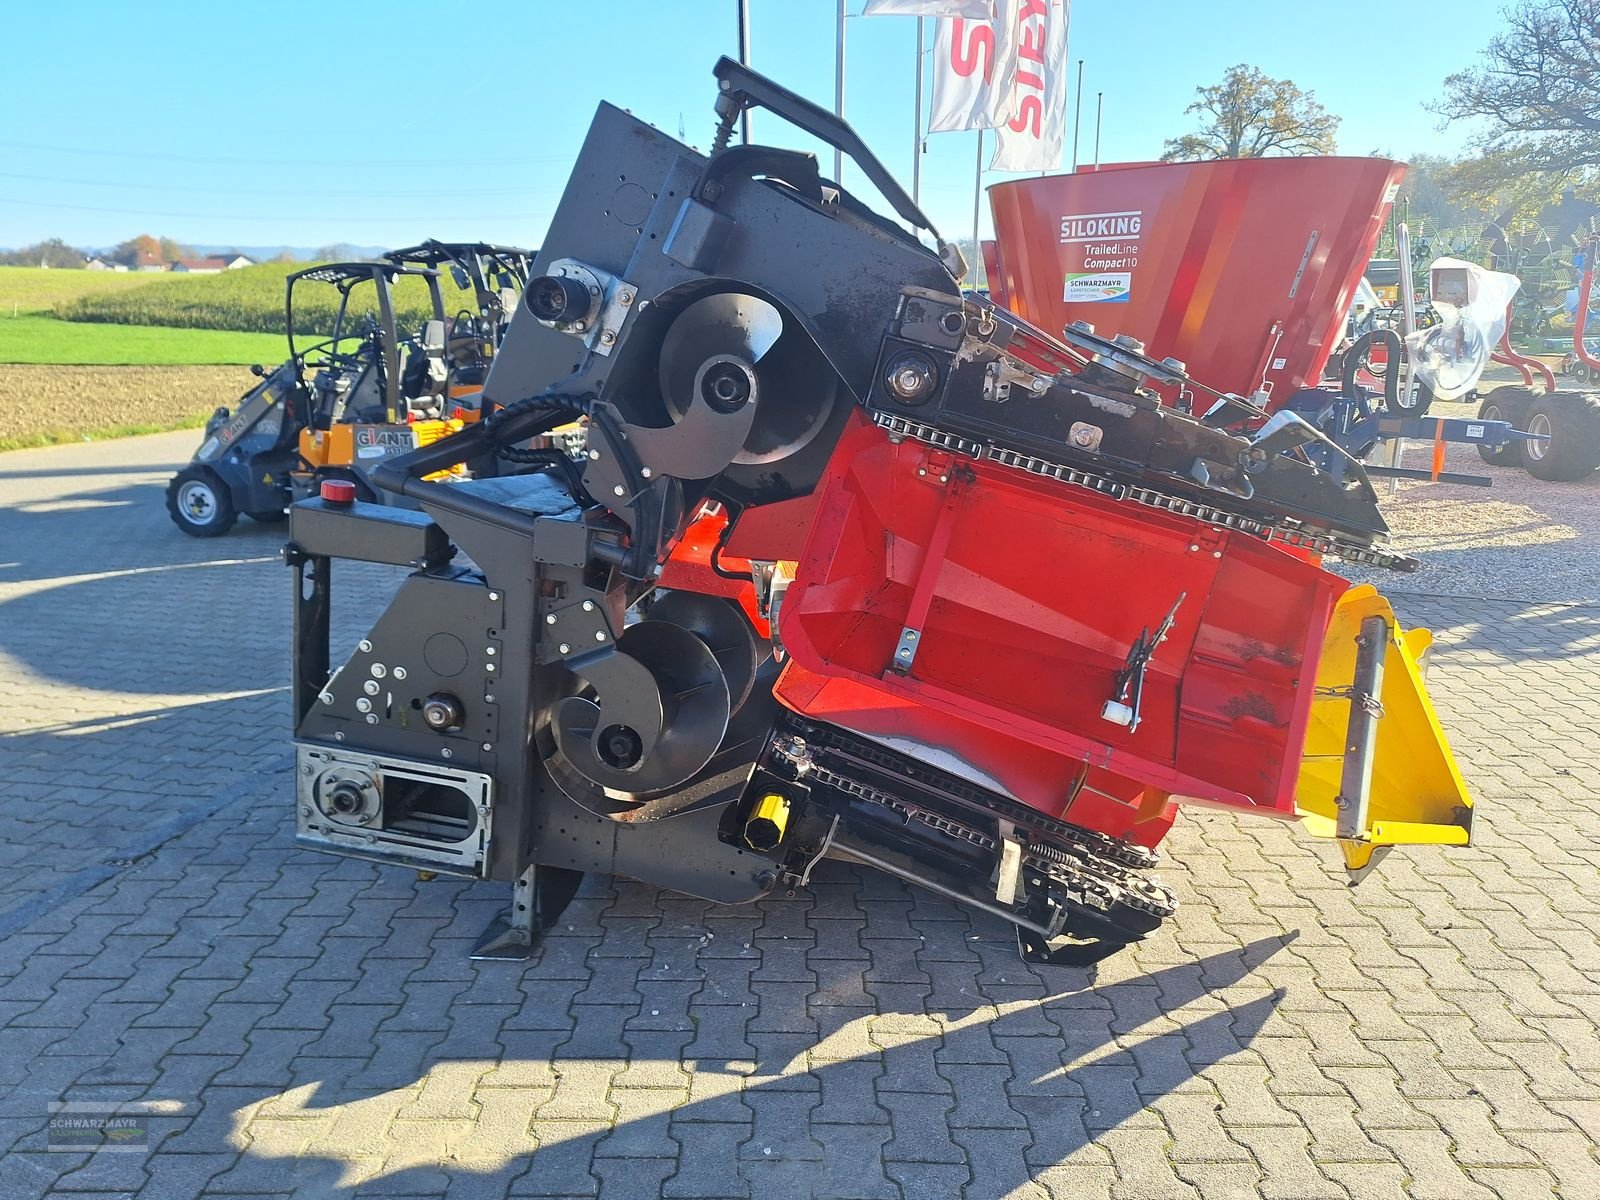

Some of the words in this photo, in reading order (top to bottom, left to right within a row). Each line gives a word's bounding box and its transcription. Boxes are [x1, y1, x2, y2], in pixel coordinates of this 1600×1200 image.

[1060, 217, 1141, 238] SILOKING
[1084, 243, 1138, 255] TrailedLine
[357, 428, 412, 447] GIANT
